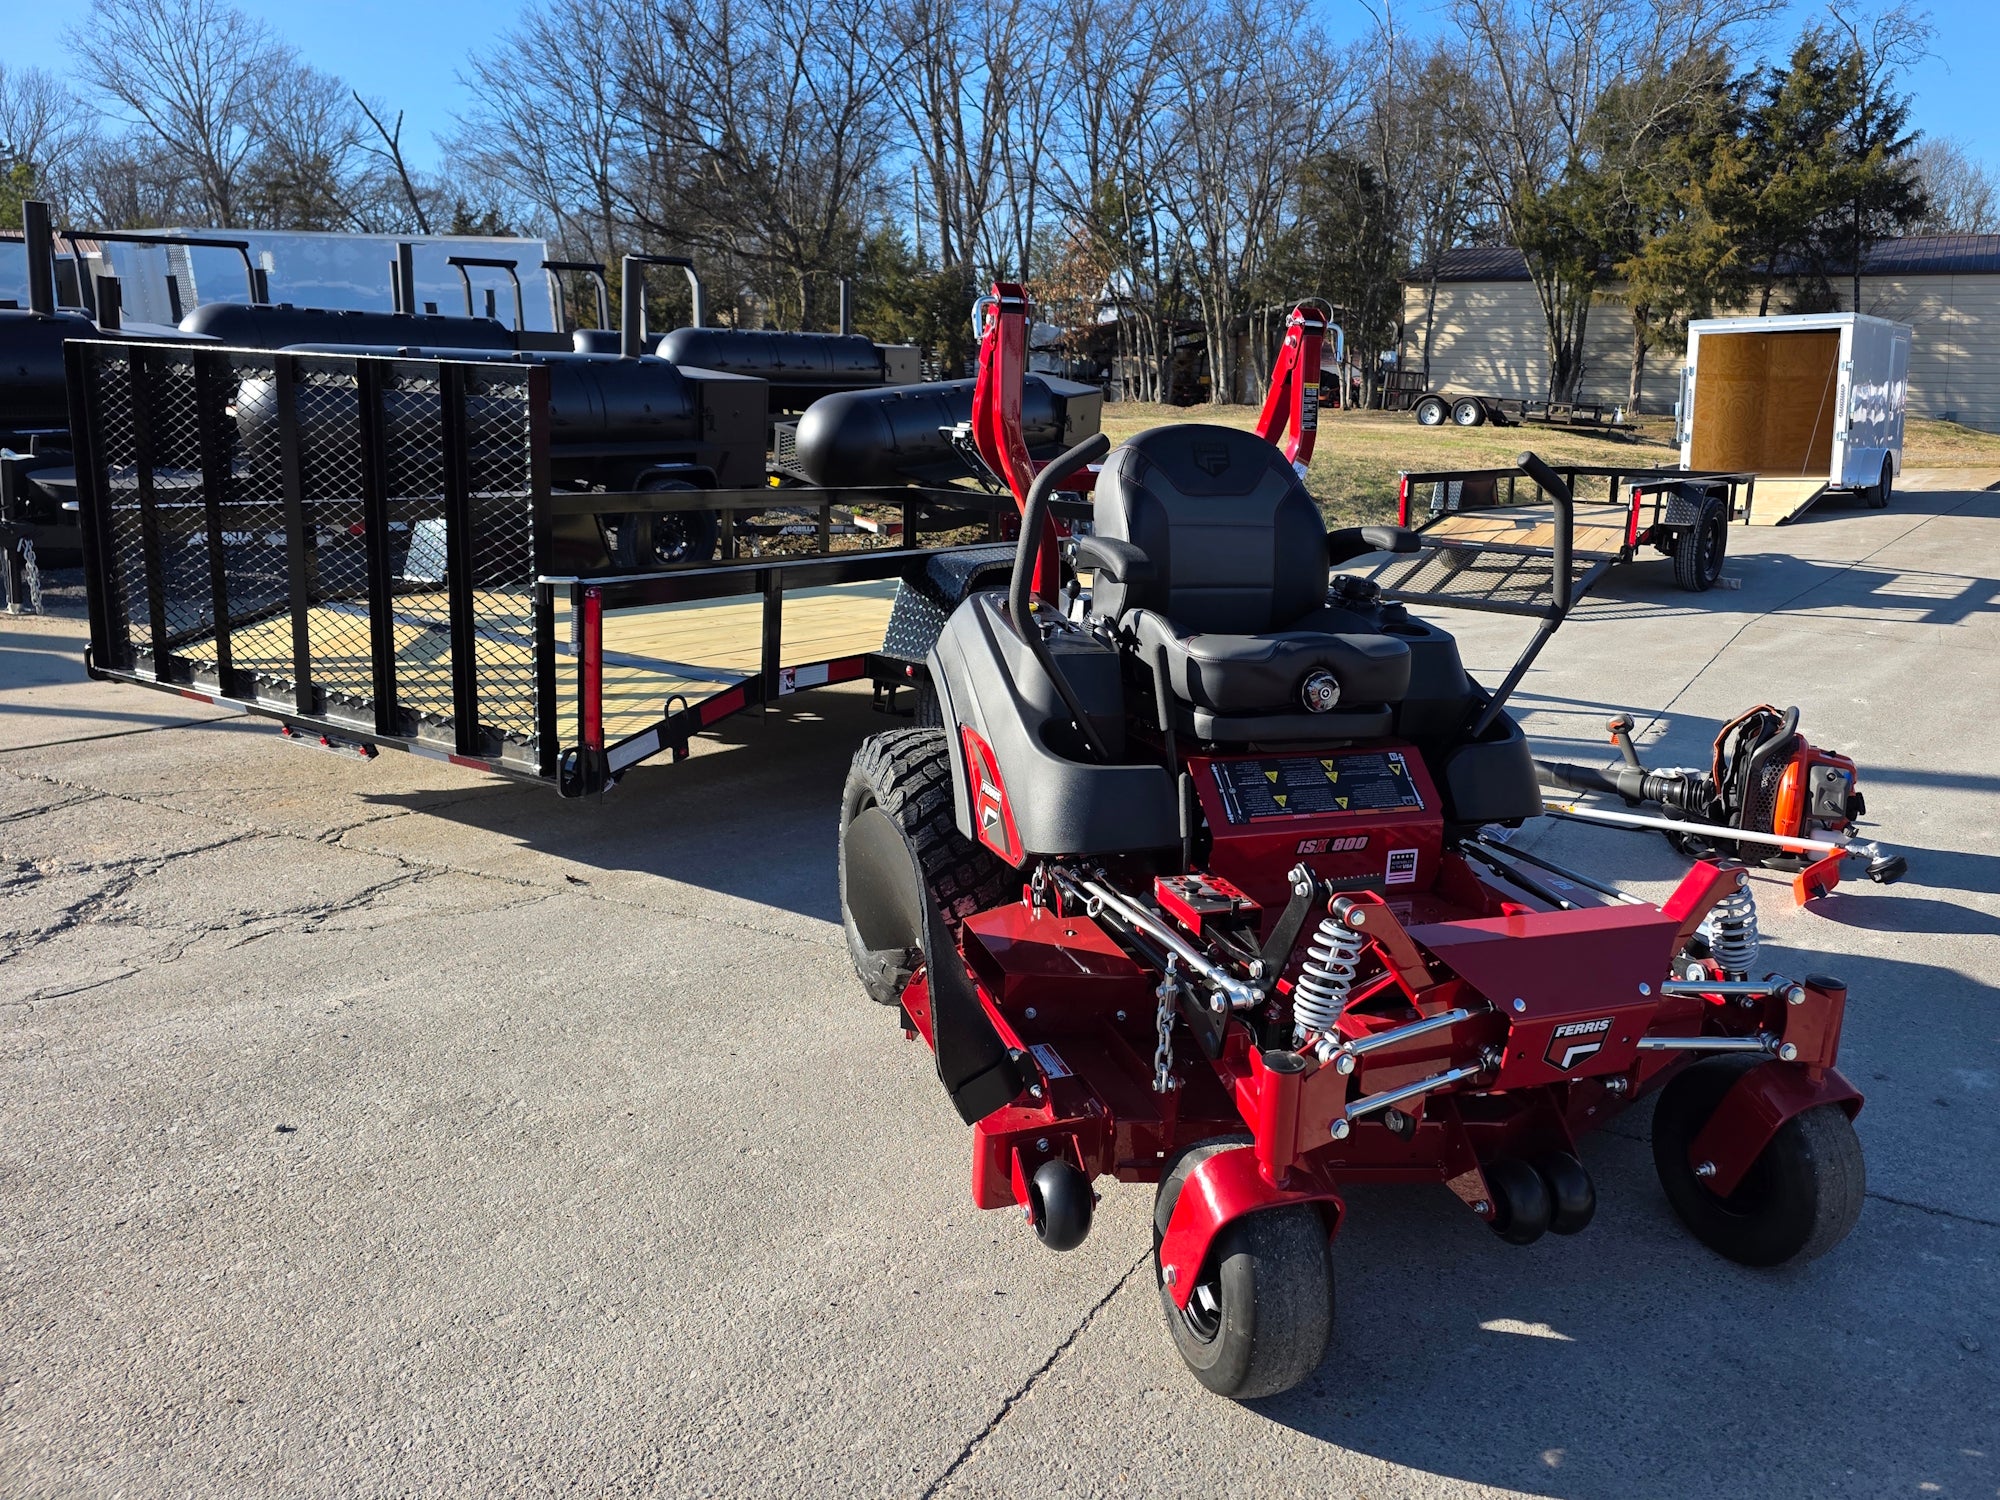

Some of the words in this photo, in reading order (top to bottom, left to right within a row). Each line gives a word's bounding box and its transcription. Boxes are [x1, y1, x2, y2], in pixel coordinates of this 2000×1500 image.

[1297, 840, 1330, 854] ISX
[1332, 837, 1368, 851] 800
[1555, 1020, 1610, 1038] FERRIS
